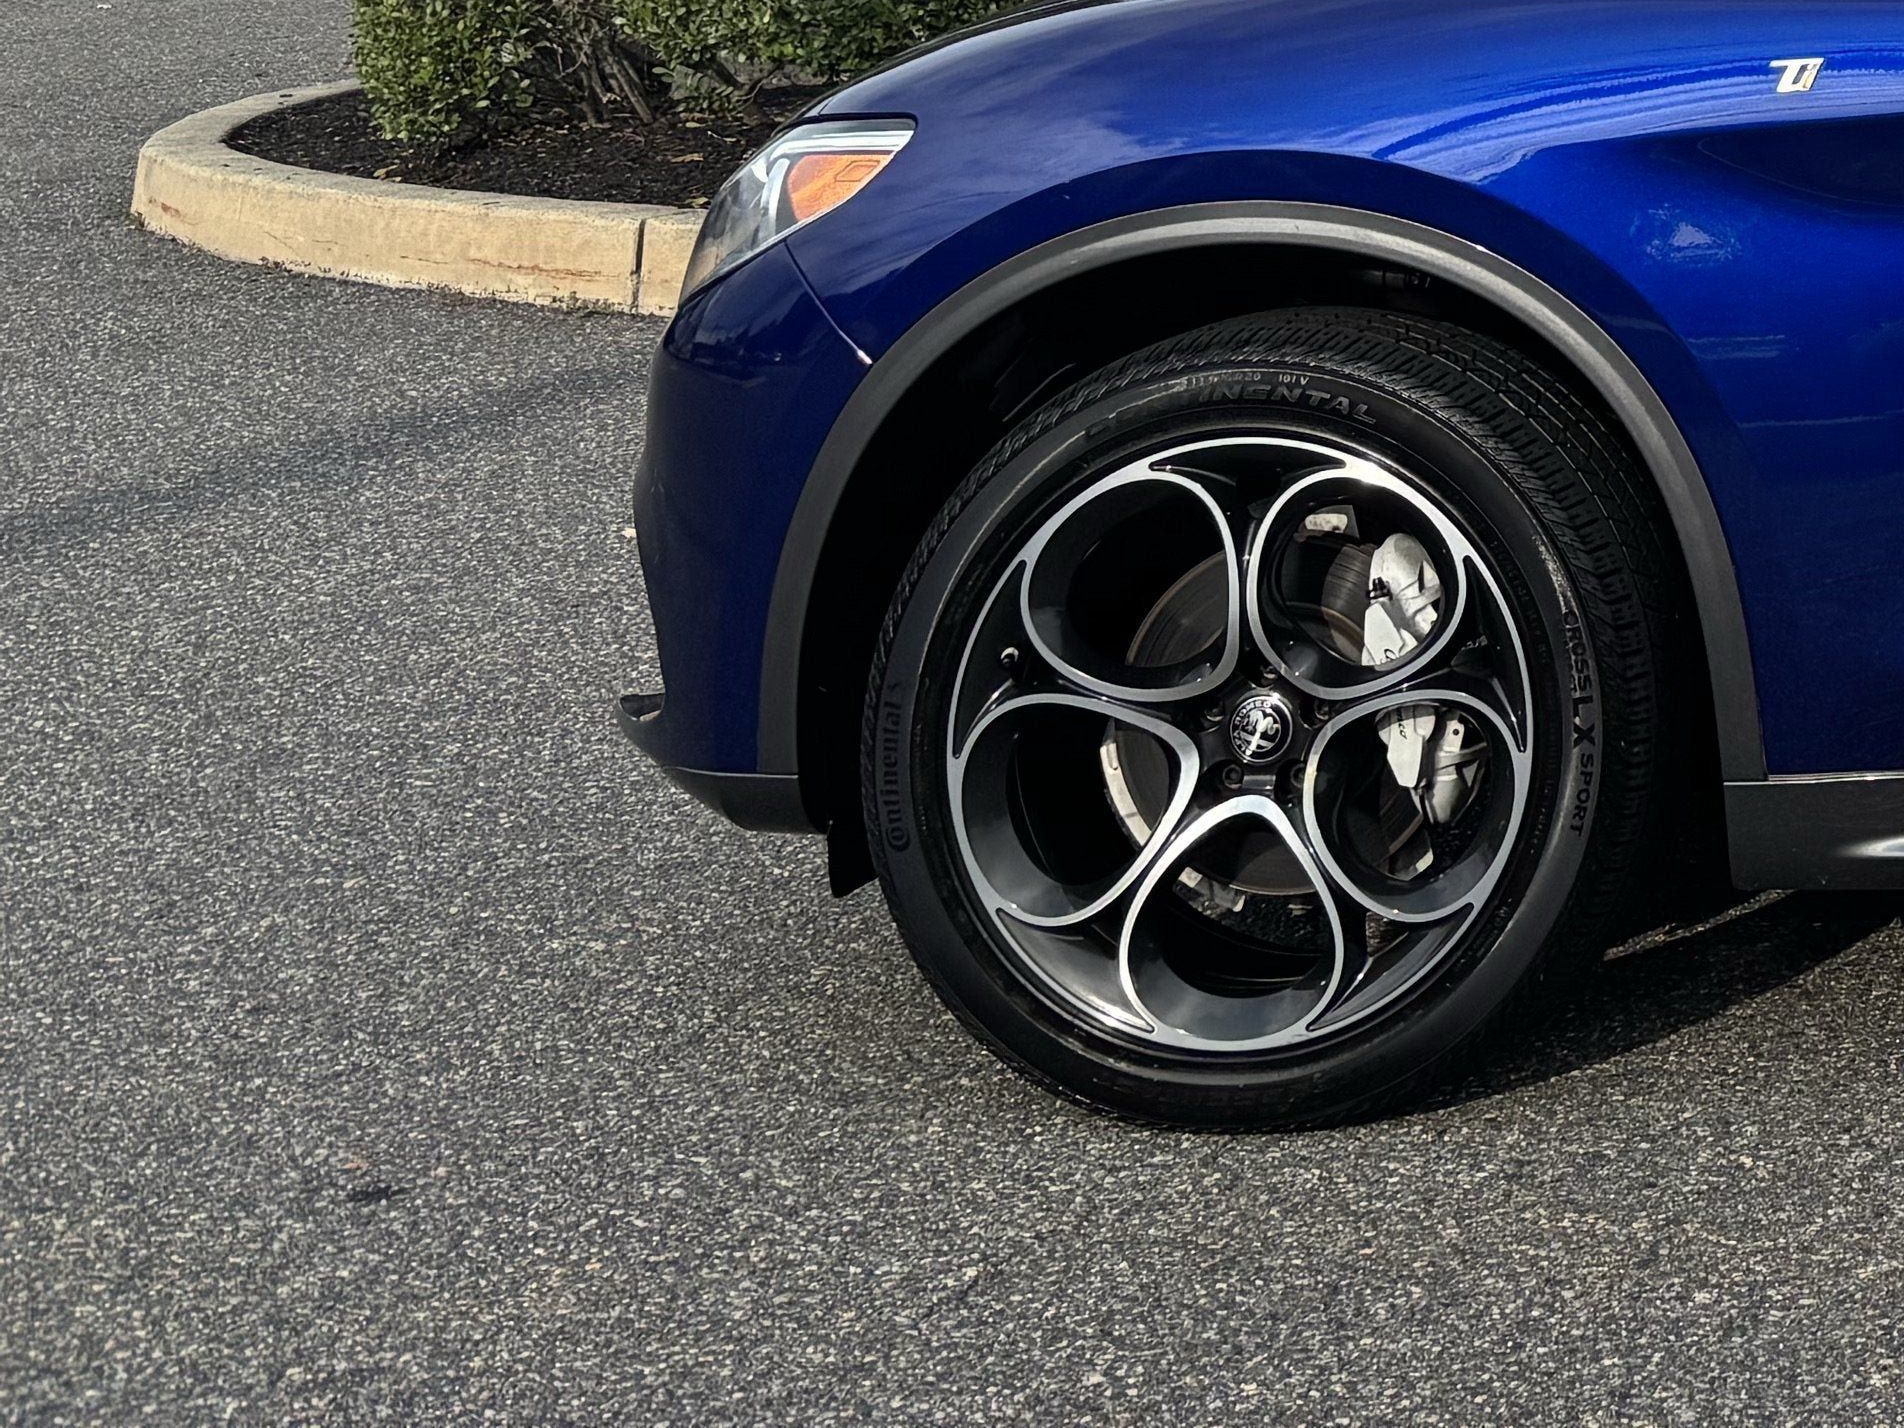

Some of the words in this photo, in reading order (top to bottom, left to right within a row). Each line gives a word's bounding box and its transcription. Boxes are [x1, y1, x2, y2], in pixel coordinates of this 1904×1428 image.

[1572, 695, 1595, 749] LX
[883, 700, 910, 852] Continental
[1571, 752, 1594, 836] SPORT
